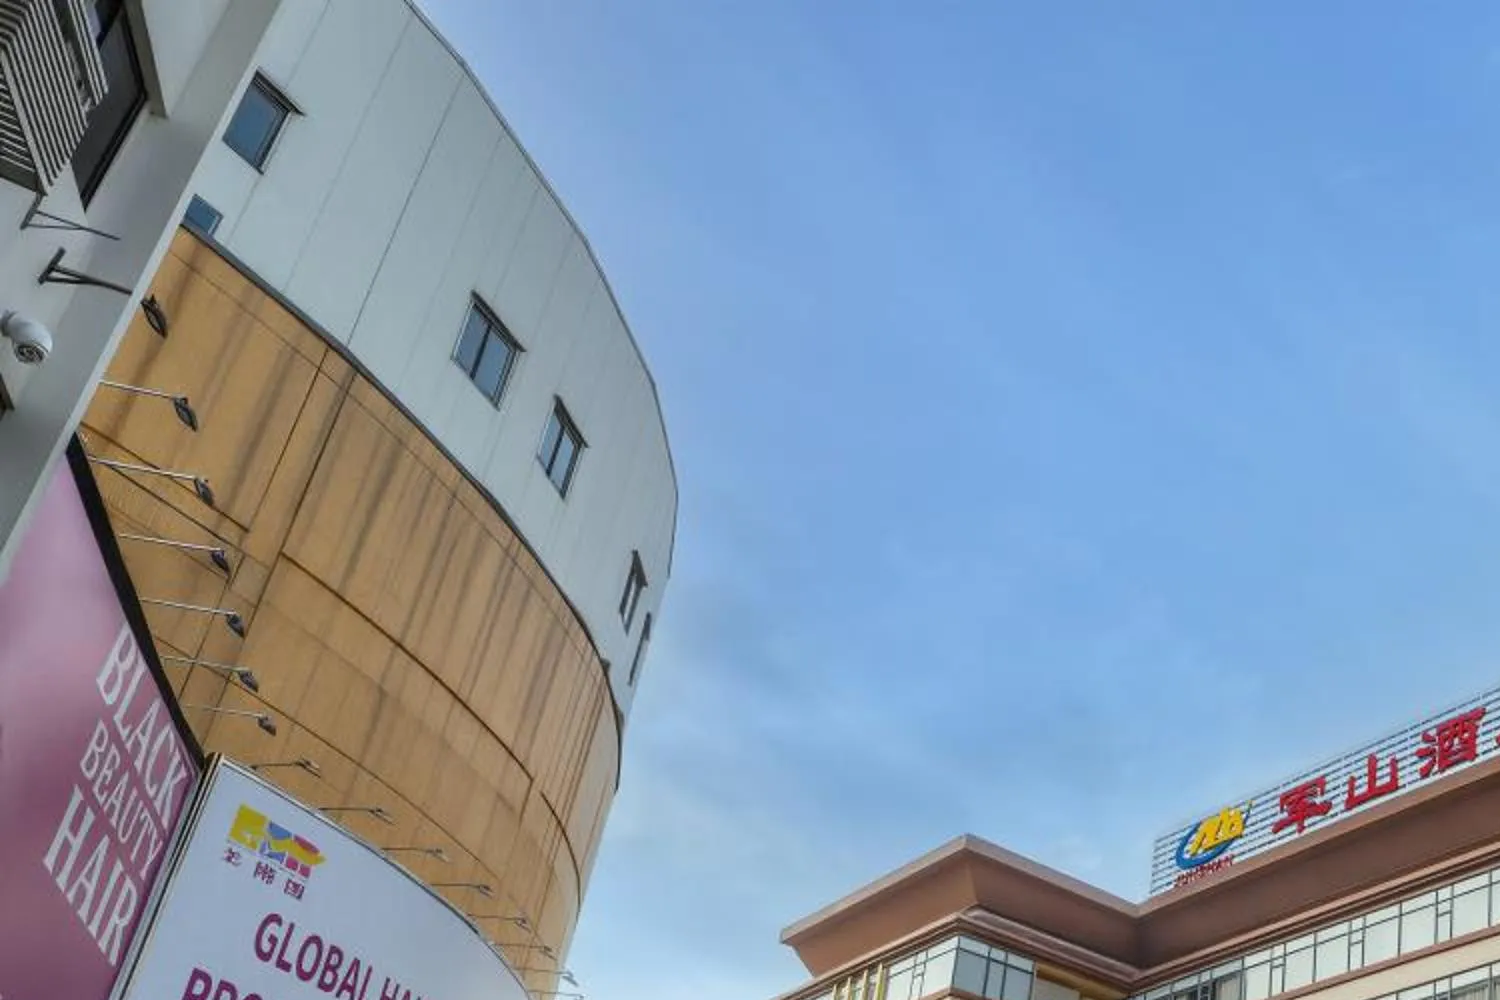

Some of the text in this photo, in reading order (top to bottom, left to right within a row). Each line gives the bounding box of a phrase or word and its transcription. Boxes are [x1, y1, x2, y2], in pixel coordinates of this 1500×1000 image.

[80, 719, 163, 881] BEAUTY
[96, 621, 189, 830] BLACK
[42, 783, 139, 967] HAIR
